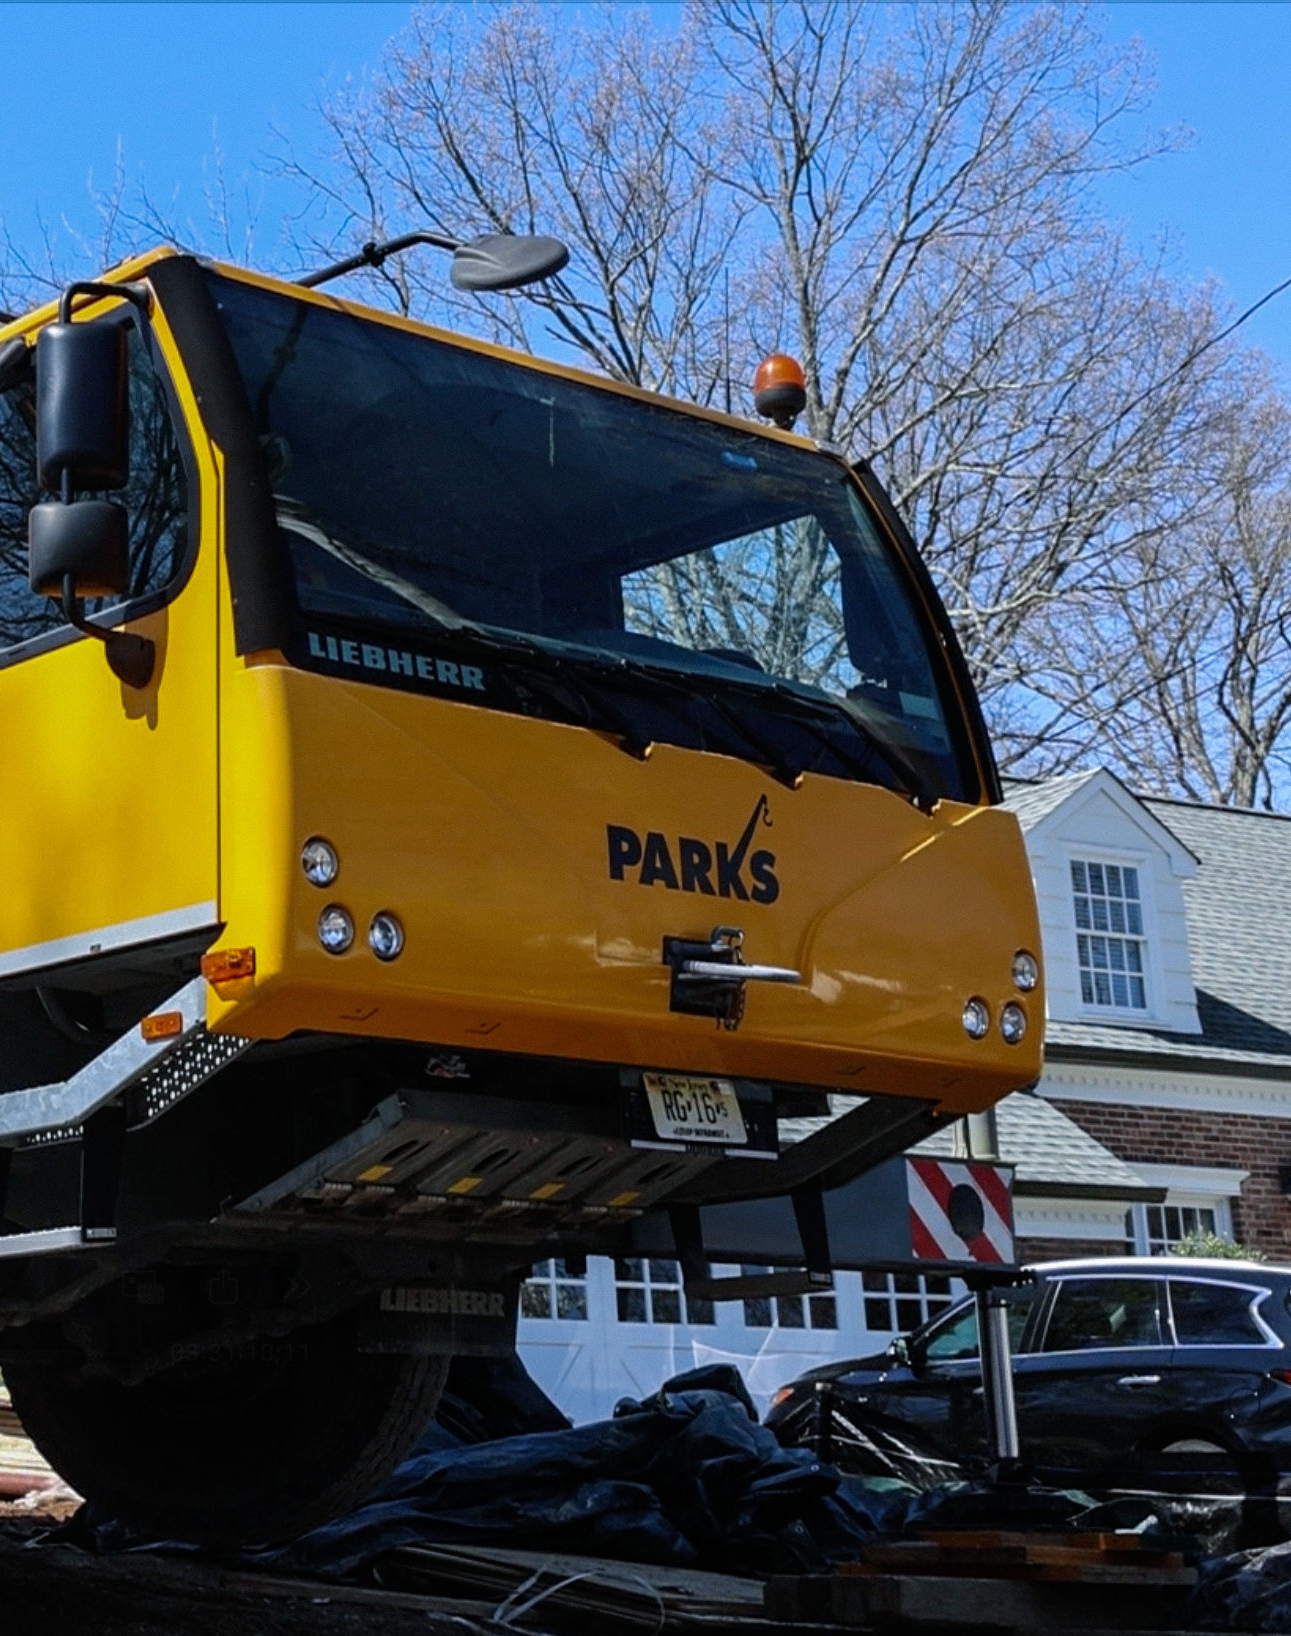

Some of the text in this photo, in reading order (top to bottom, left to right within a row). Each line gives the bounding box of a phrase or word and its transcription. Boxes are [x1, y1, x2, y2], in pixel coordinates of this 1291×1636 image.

[308, 632, 486, 691] LIEBHERR
[607, 796, 779, 905] PARKS
[379, 1286, 506, 1318] LIEBHERR
